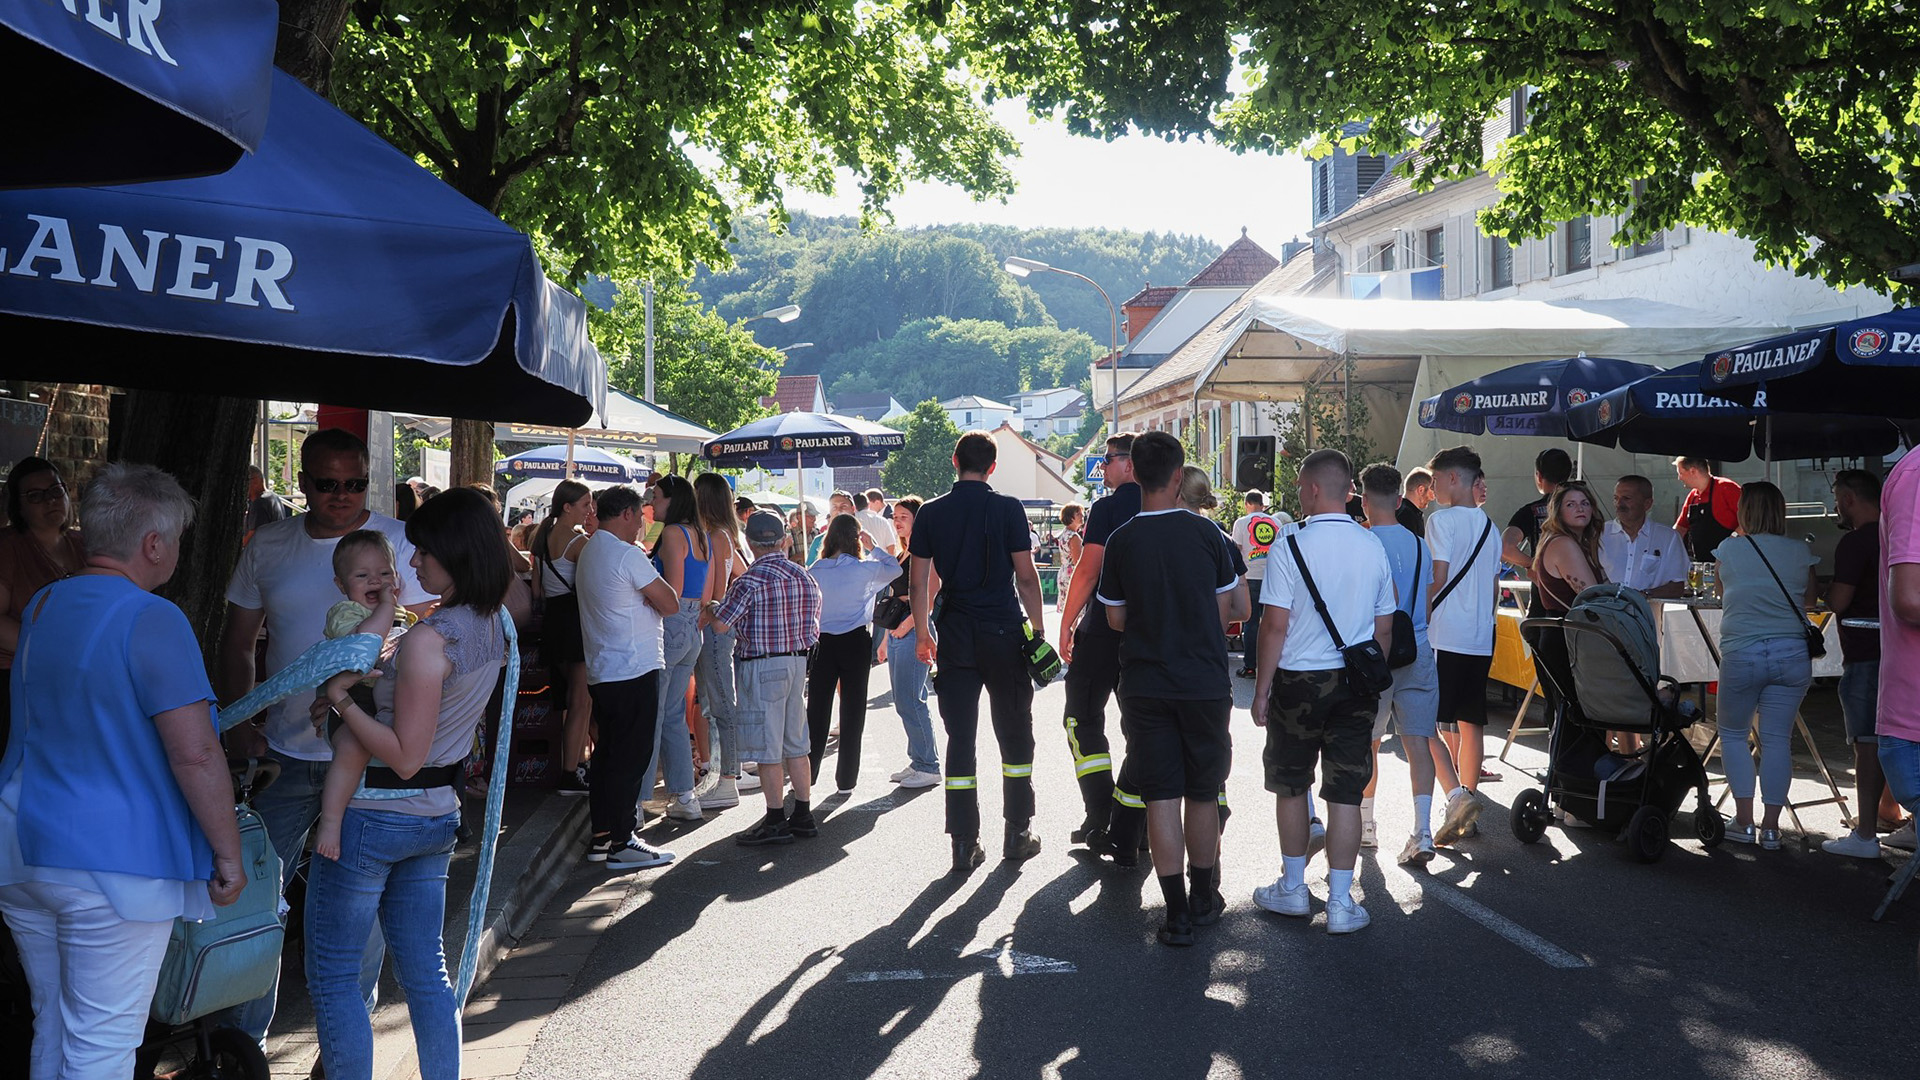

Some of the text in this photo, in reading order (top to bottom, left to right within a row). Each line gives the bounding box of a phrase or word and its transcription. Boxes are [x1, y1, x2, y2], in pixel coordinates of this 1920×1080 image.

[1732, 338, 1821, 374] PAULANER
[1474, 390, 1549, 409] PAULANER
[723, 439, 770, 454] PAULANER
[795, 435, 852, 448] PAULANER
[868, 435, 903, 446] PAULANER
[523, 461, 560, 470] PAULANER
[578, 463, 619, 475] PAULANER
